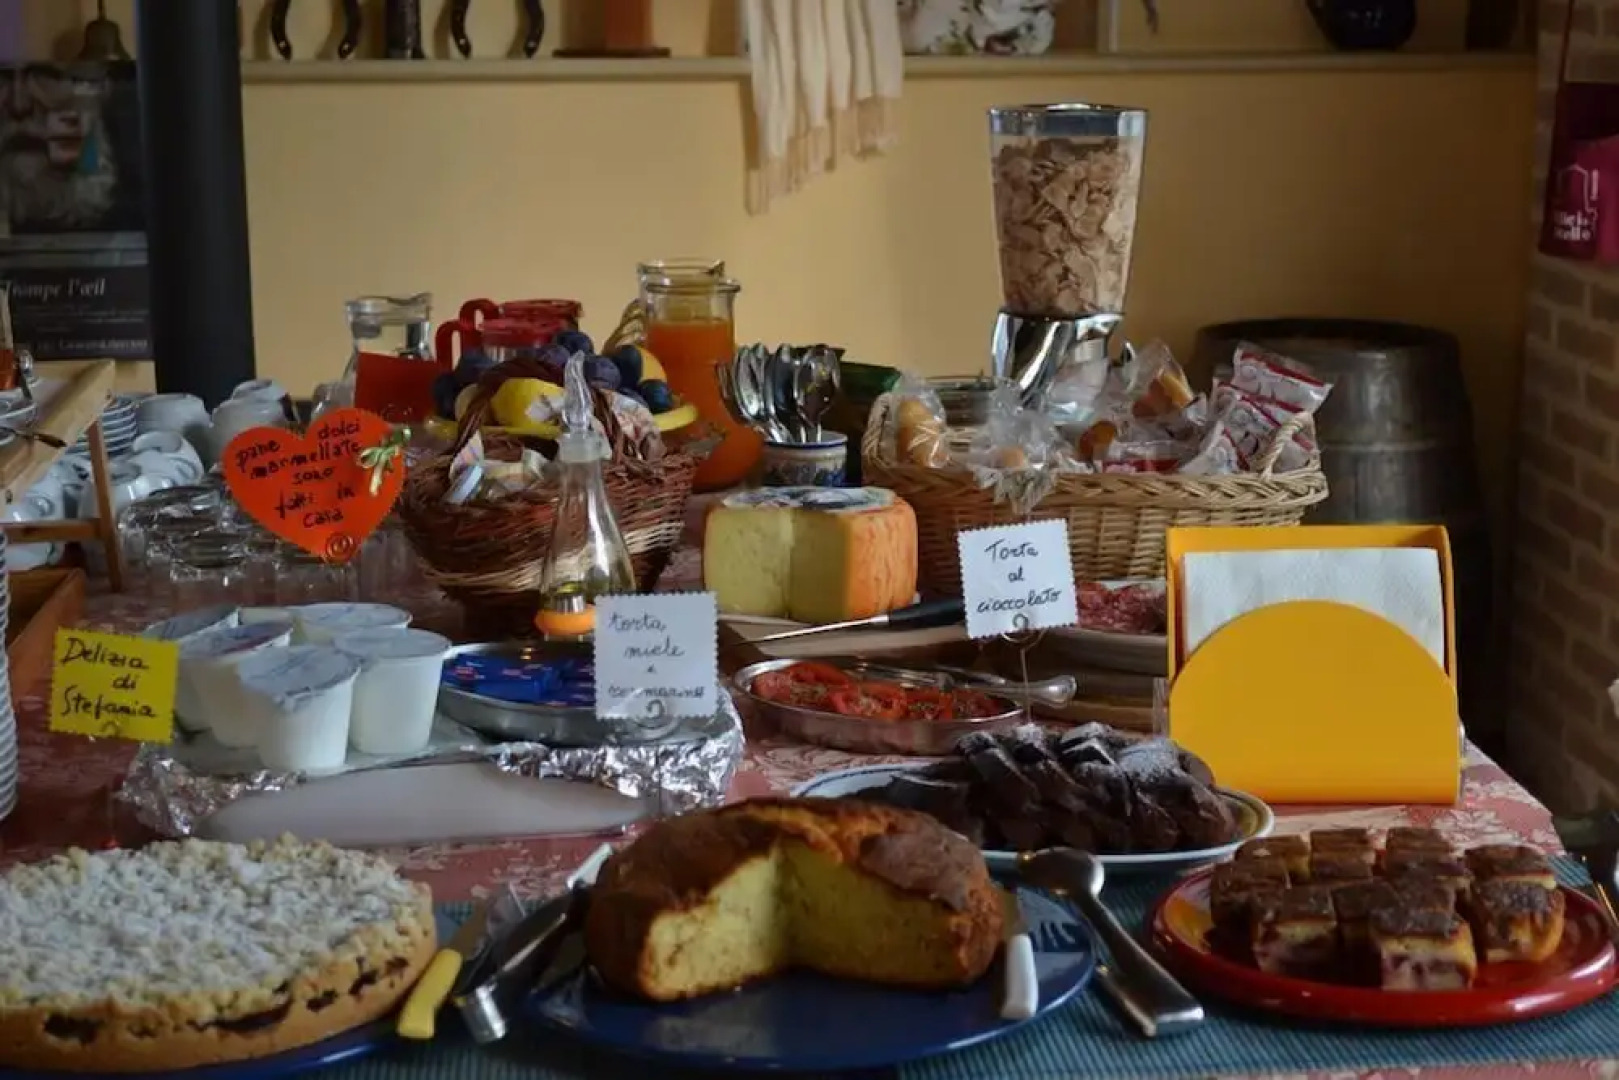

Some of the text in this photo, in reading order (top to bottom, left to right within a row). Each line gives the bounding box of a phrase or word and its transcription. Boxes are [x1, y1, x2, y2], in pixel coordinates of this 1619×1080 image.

[235, 418, 361, 474] pane dolci
[250, 440, 363, 480] marmellate
[336, 482, 356, 501] in
[983, 538, 1039, 564] Torta
[1007, 565, 1024, 582] al
[976, 587, 1063, 613] cioccolato
[608, 611, 667, 632] torta
[60, 637, 150, 670] Delizia
[623, 635, 686, 658] miele
[112, 673, 140, 691] di
[60, 684, 157, 720] Stefania
